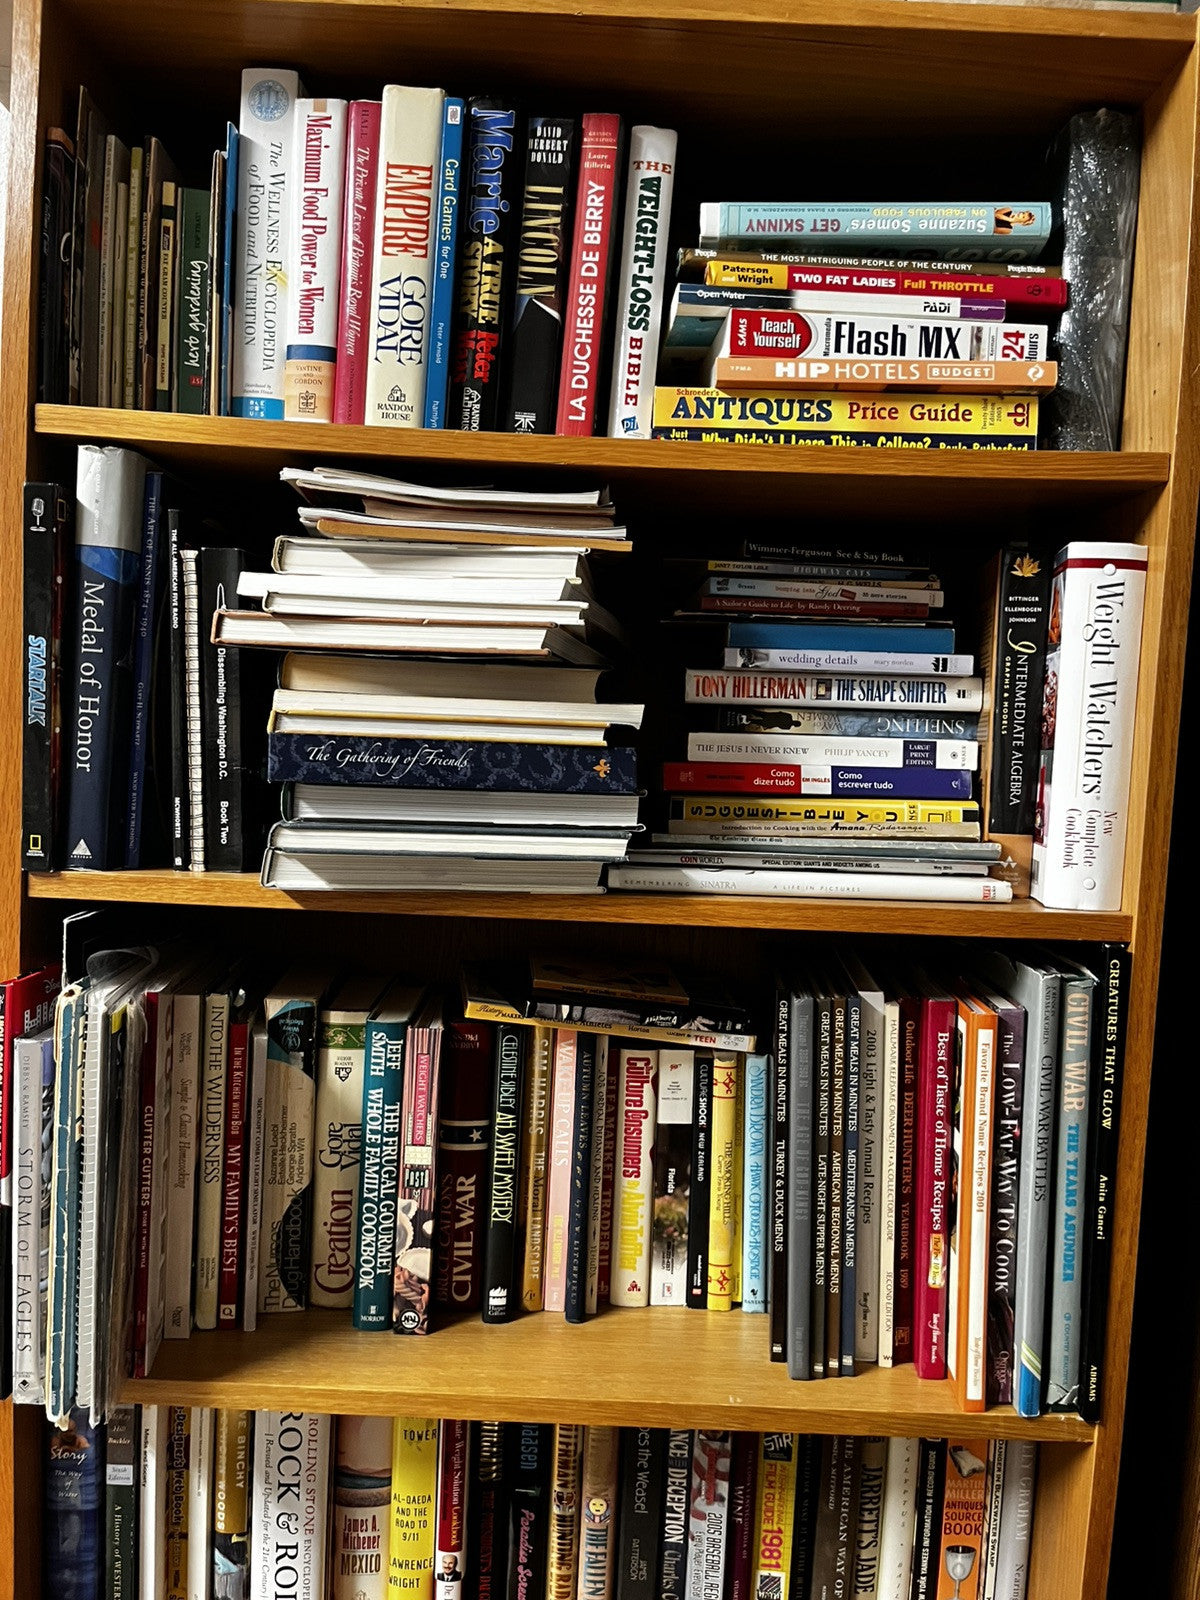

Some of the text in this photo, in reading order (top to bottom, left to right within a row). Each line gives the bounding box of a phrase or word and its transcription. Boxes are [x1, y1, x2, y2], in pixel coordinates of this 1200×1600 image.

[528, 139, 569, 152] HERBERT
[536, 126, 562, 138] DAVID
[470, 108, 515, 235] Marie
[531, 152, 564, 165] DONALD
[633, 161, 672, 175] THE
[298, 115, 332, 334] Maximum Food Power for Women
[383, 161, 433, 259] EMPIRE
[746, 217, 987, 233] Suzanne Somers' GET SKINNY
[518, 185, 564, 299] LINCOLN
[722, 265, 769, 275] Paterson
[737, 274, 774, 286] Wright
[761, 254, 973, 271] THE MOST INTRIGUING PEOPLE OF THE CENTURY
[624, 176, 661, 406] WEIGHT-LOSS BIBLE
[793, 274, 896, 289] TWO FAT LADIES
[904, 279, 994, 293] Full THROTTLE
[183, 259, 208, 367] herb gardening
[374, 273, 402, 365] VIDAL
[399, 272, 426, 367] GORE
[569, 181, 605, 421] LA DUCHESSE DE BERRY
[753, 333, 801, 348] Yourself
[760, 318, 794, 334] Teach
[834, 322, 962, 359] Flash MX
[775, 362, 991, 380] HIP HOTELS BUDGET
[377, 402, 414, 413] RANDOM
[676, 388, 720, 397] Schroeder's
[381, 412, 411, 422] HOUSE
[671, 398, 973, 425] ANTIQUES Price Guide
[76, 580, 104, 772] Medal of Honor
[778, 654, 858, 668] wedding details
[28, 636, 48, 726] STARTALK
[693, 674, 807, 700] TONY HILLERMAN
[835, 679, 947, 704] THE SHAPE SHIFTER
[1082, 581, 1126, 796] Weight Watchers
[217, 648, 227, 779] Dissembling Washington D.C.
[877, 718, 965, 735] SNELLING
[306, 741, 474, 779] The Gathering of Friends
[696, 744, 809, 756] THE JESUS I NEVER KNEW
[906, 758, 933, 766] EDITION
[908, 743, 931, 752] LARGE
[909, 751, 929, 759] PRINT
[753, 777, 774, 786] dizer
[776, 777, 795, 787] tudo
[771, 769, 795, 778] Como
[838, 771, 863, 781] Como
[838, 780, 894, 790] escrever tudo
[220, 801, 228, 844] Book Two
[1062, 808, 1081, 868] Cookbook
[1080, 809, 1101, 867] Complete
[1103, 811, 1117, 836] New
[370, 1032, 385, 1076] SMITH
[386, 1040, 402, 1070] JEFF
[1101, 959, 1120, 1130] CREATURES THAT GLOW
[203, 1005, 225, 1183] INTO THE WILDERNESS
[319, 1122, 344, 1168] Gore
[930, 1032, 949, 1230] Best of Taste of Home Recipes
[1034, 1056, 1054, 1202] CIVIL WAR BATTLES
[1062, 993, 1090, 1282] CIVIL WAR THE YEARS ASUNDER
[140, 1105, 154, 1206] CLUTTER CUTTERS
[358, 1088, 383, 1289] WHOLE FAMILY COOKBOOK
[376, 1102, 400, 1276] THE FRUGAL GOURMET
[667, 1167, 675, 1194] Florida
[223, 1144, 241, 1274] MY FAMILY'S BEST
[17, 1148, 33, 1352] STORM OF EAGLES
[314, 1189, 355, 1294] Creation
[451, 1174, 476, 1301] CIVIL WAR
[50, 1447, 88, 1466] Story
[236, 1436, 245, 1488] BINCHY
[303, 1418, 318, 1535] ROLLING STONE
[634, 1471, 650, 1513] Weasel
[343, 1515, 380, 1533] James A.
[664, 1468, 687, 1543] DECEPTION
[761, 1463, 783, 1569] FILM GUIDE 1981
[836, 1464, 852, 1576] AMERICAN WAY
[945, 1501, 983, 1510] ANTIQUES
[945, 1512, 982, 1521] SOURCE
[343, 1534, 380, 1550] Michener
[705, 1513, 722, 1580] 2005 BASEBALL
[854, 1464, 883, 1594] JARRETT'S JADE
[944, 1523, 982, 1535] BOOK
